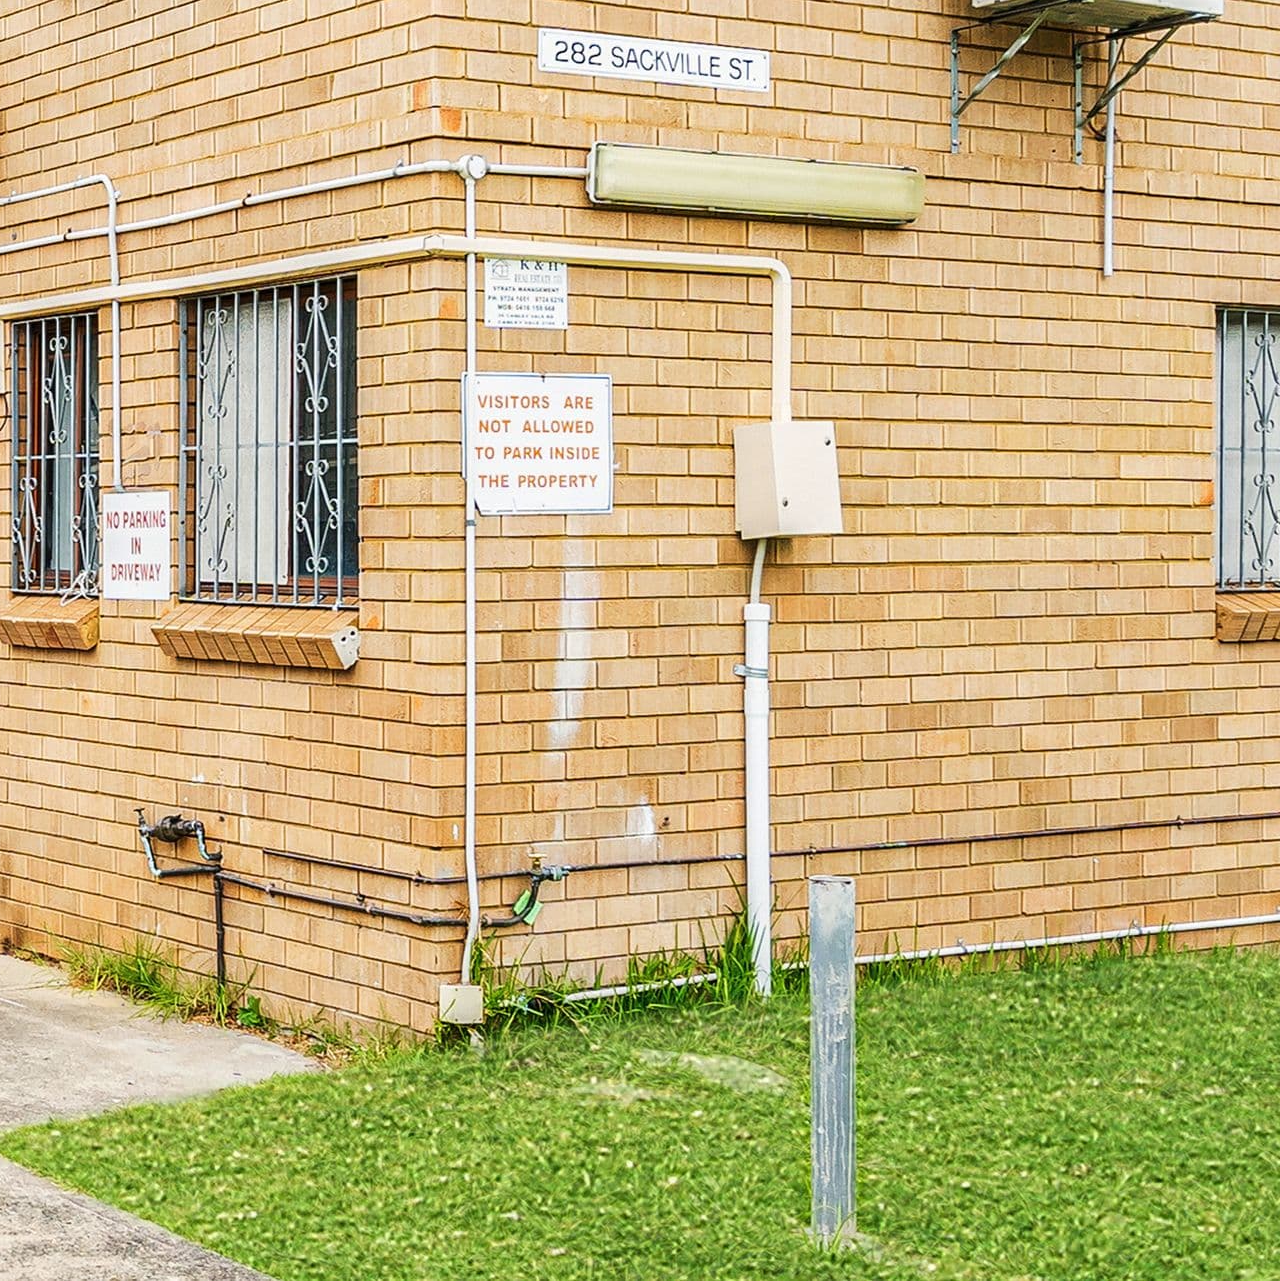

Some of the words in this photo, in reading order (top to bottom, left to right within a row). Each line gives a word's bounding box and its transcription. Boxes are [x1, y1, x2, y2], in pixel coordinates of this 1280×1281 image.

[554, 40, 603, 66] 282
[611, 46, 721, 78] SACKVILLE
[729, 57, 756, 82] ST.
[520, 259, 529, 270] K
[534, 260, 544, 270] &
[478, 395, 550, 409] VISITORS
[564, 396, 593, 409] ARE
[478, 420, 511, 433] NOT
[522, 420, 594, 434] ALLOWED
[475, 446, 495, 460] TO
[503, 446, 543, 460] PARK
[550, 447, 600, 460] INSIDE
[478, 475, 509, 488] THE
[518, 475, 598, 488] PROPERTY
[106, 511, 120, 529] NO
[123, 510, 166, 529] PARKING
[131, 536, 141, 555] IN
[111, 563, 161, 581] DRIVEWAY
